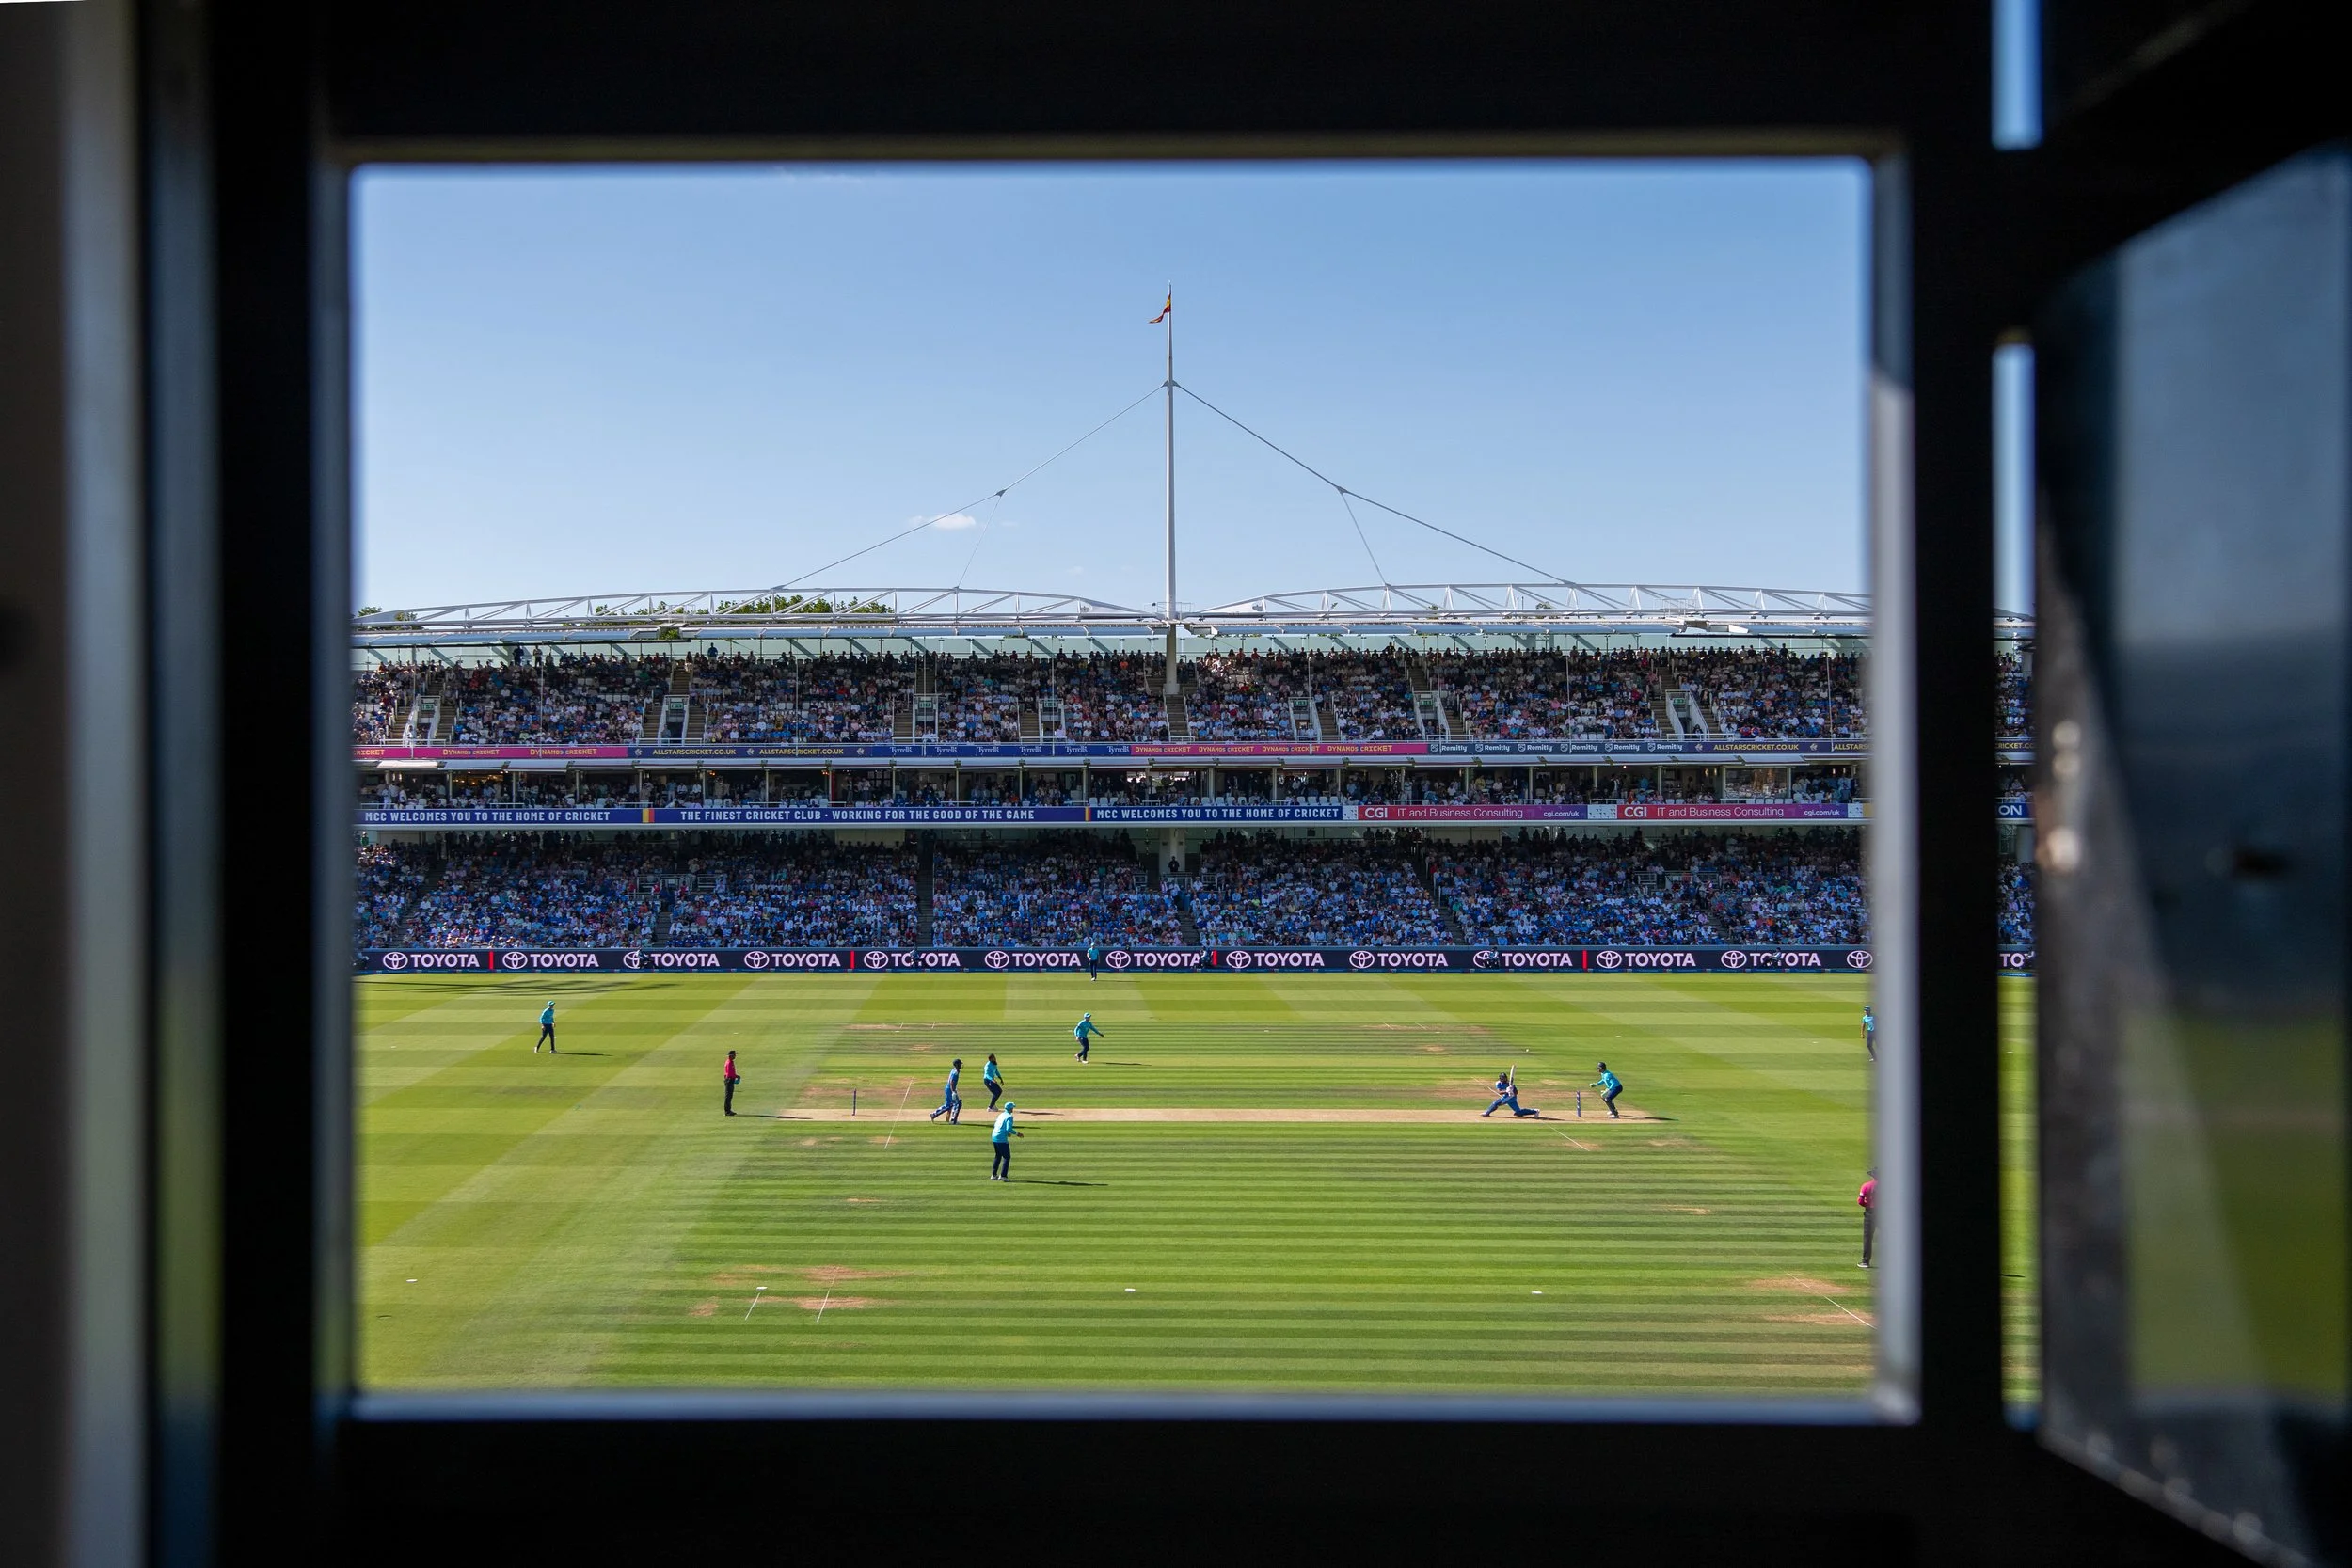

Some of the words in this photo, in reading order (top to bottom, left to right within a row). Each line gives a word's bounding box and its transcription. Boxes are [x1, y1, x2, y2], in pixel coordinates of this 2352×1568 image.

[365, 812, 387, 821] MCC
[390, 812, 447, 821] WELCOMES
[451, 812, 471, 821] YOU
[475, 812, 488, 821] TO
[492, 811, 512, 820] THE
[516, 811, 545, 820] HOME
[548, 811, 562, 820] OF
[565, 811, 610, 820] CRICKET
[681, 811, 701, 820] THE
[705, 811, 742, 820] FINEST
[746, 811, 790, 820] CRICKET
[794, 811, 821, 820] CLUB
[833, 811, 882, 820] WORKING
[885, 811, 905, 820] FOR
[909, 810, 930, 819] THE
[933, 810, 961, 819] GOOD
[965, 810, 978, 819] OF
[982, 810, 1002, 819] THE
[1007, 810, 1035, 819] GAME
[1097, 809, 1118, 819] MCC
[1121, 809, 1178, 818] WELCOMES
[1182, 809, 1200, 818] YOU
[1205, 809, 1217, 818] TO
[1222, 809, 1242, 818] THE
[1246, 809, 1274, 818] HOME
[1278, 809, 1291, 818] OF
[1295, 808, 1339, 818] CRICKET
[1364, 807, 1388, 818] CGI
[1397, 808, 1406, 817] IT
[1409, 808, 1426, 817] and
[1430, 808, 1470, 817] Business
[1473, 808, 1523, 819] Consulting
[1544, 810, 1580, 818] cgi.com/uk
[1624, 807, 1647, 817] CGI
[1657, 807, 1665, 816] IT
[1669, 807, 1686, 816] and
[1689, 807, 1731, 816] Business
[1734, 807, 1784, 817] Consulting
[411, 954, 480, 967] TOYOTA
[530, 954, 599, 967] TOYOTA
[651, 954, 720, 967] TOYOTA
[771, 953, 841, 967] TOYOTA
[1012, 953, 1082, 966] TOYOTA
[1134, 953, 1200, 966] TOYOTA
[1254, 953, 1325, 966] TOYOTA
[1377, 953, 1448, 966] TOYOTA
[1502, 953, 1573, 966] TOYOTA
[1625, 953, 1696, 966] TOYOTA
